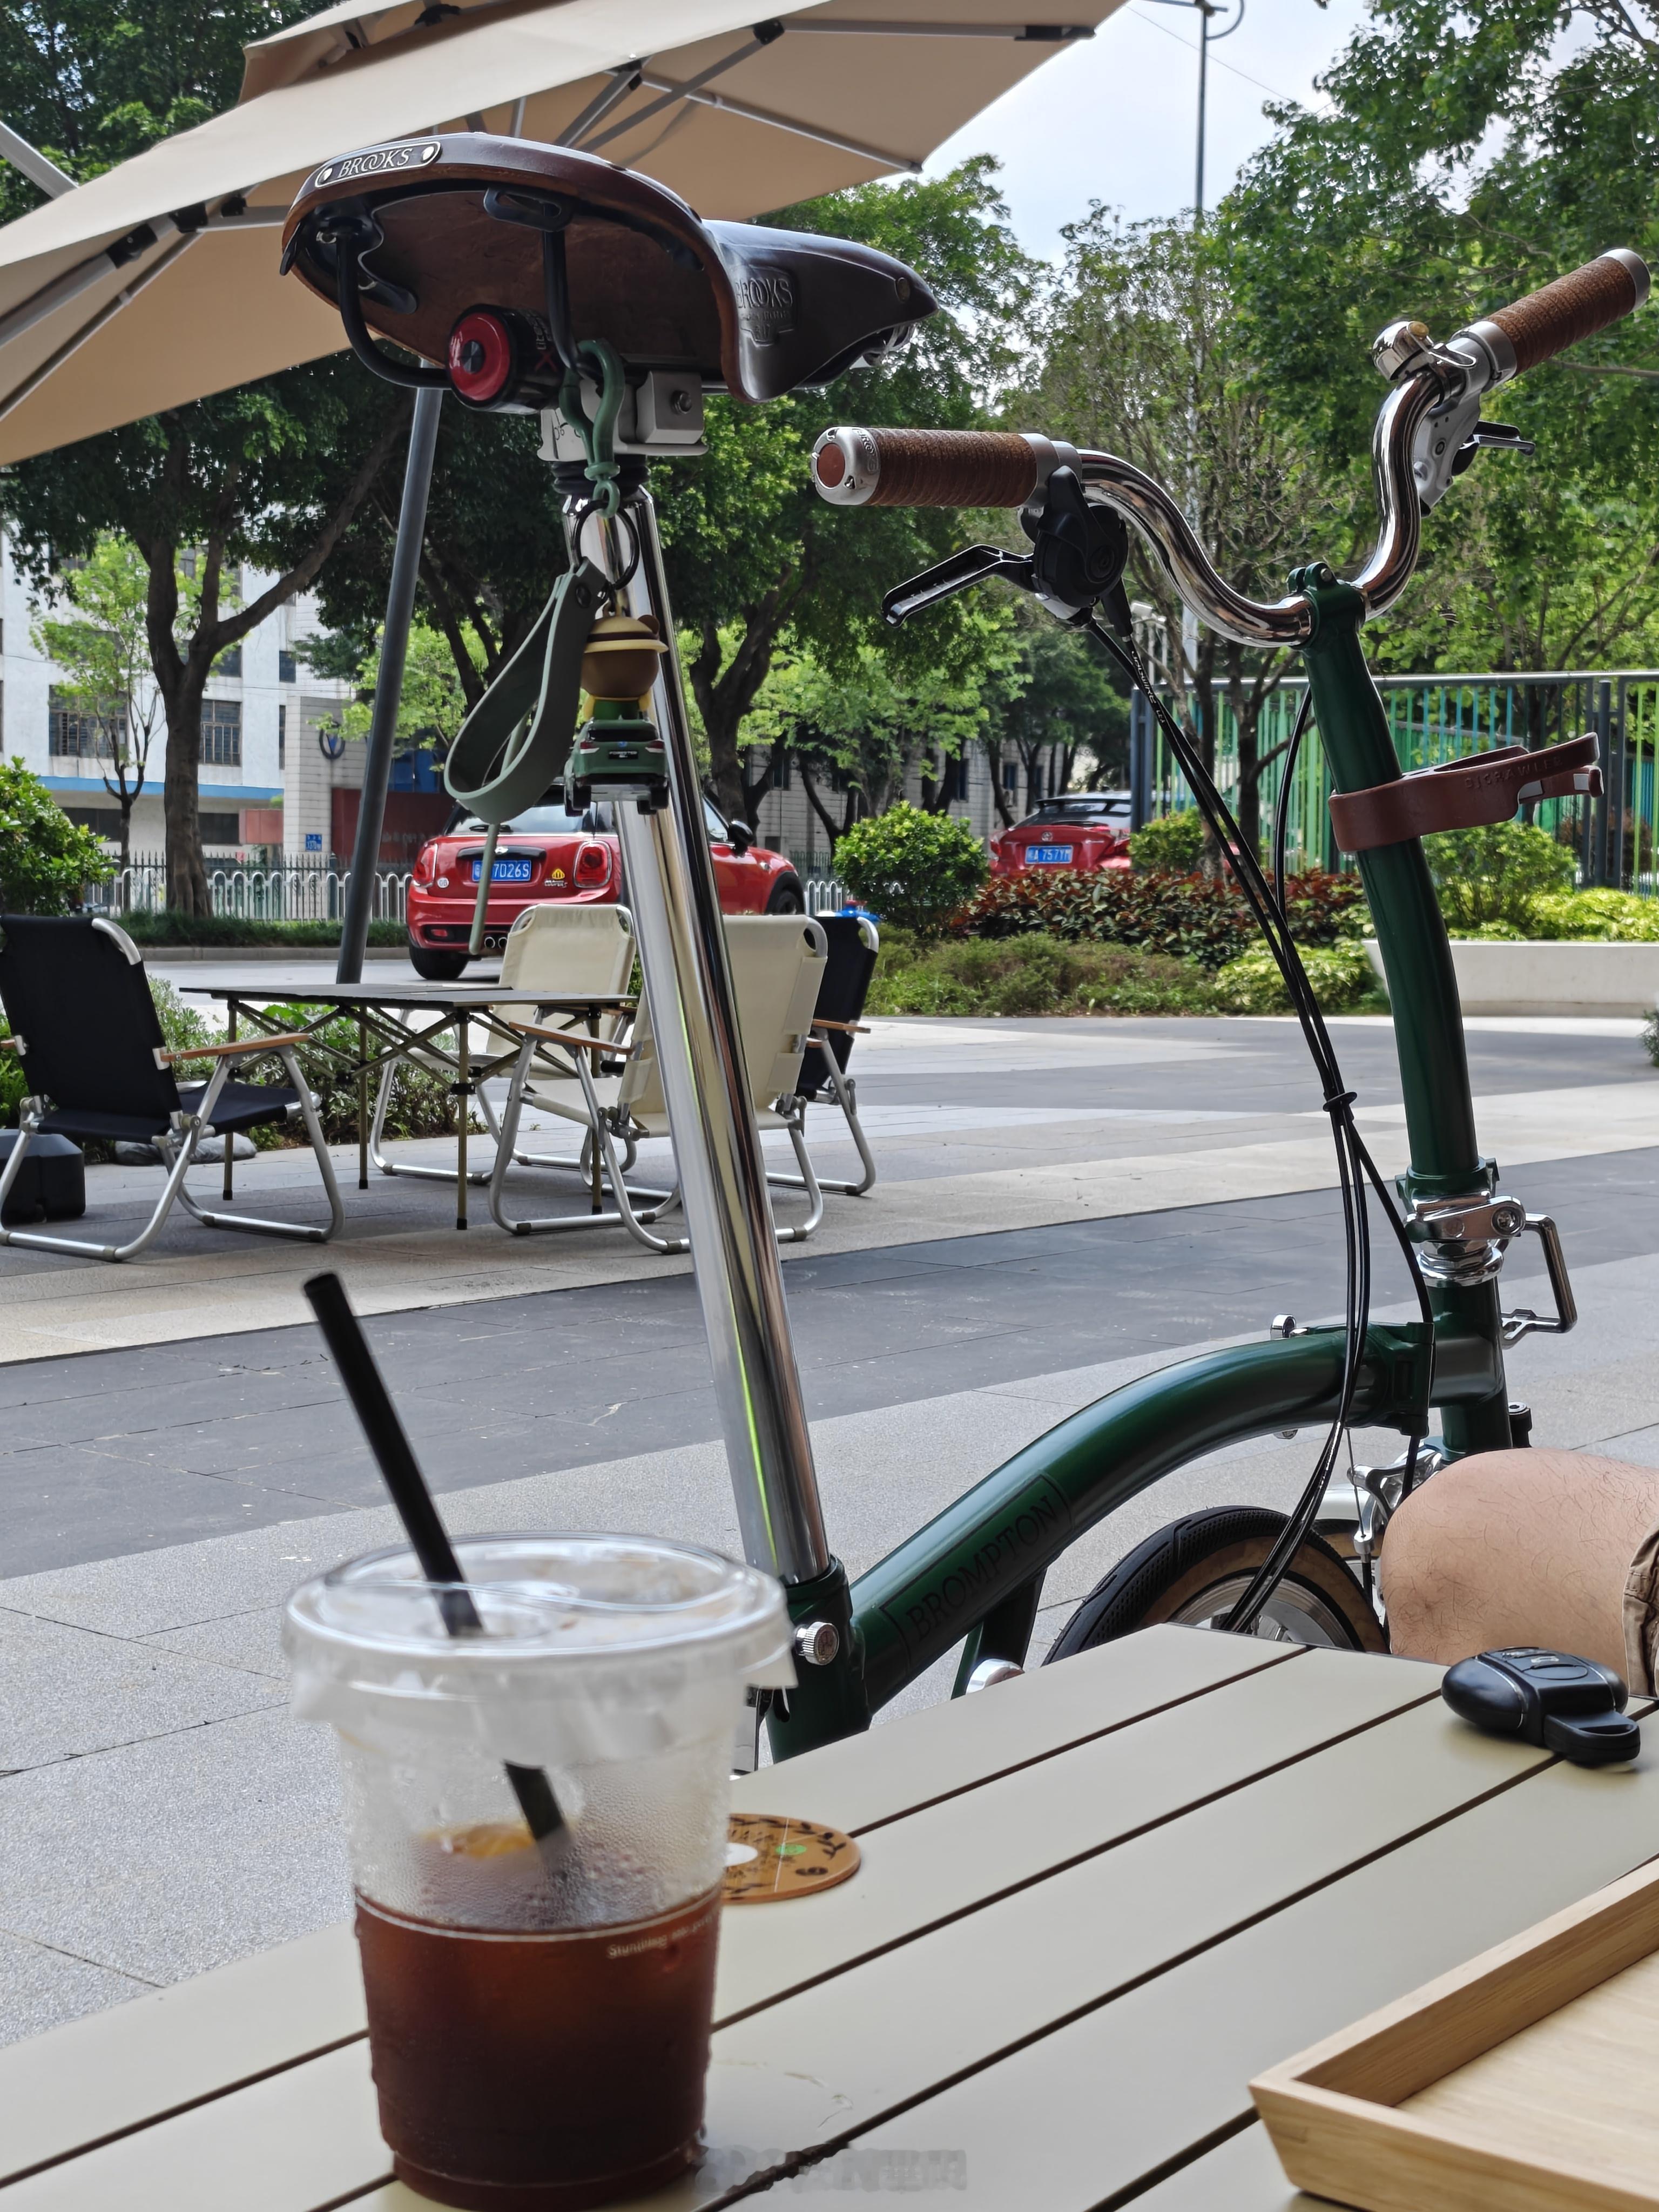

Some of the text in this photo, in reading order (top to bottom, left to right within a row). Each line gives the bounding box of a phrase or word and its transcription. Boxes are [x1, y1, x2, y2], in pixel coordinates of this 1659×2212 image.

[336, 147, 414, 179] BROOKS
[736, 277, 793, 309] BROOKS
[1131, 650, 1157, 704] JAGWIRE
[906, 1495, 1059, 1638] BROMPTON
